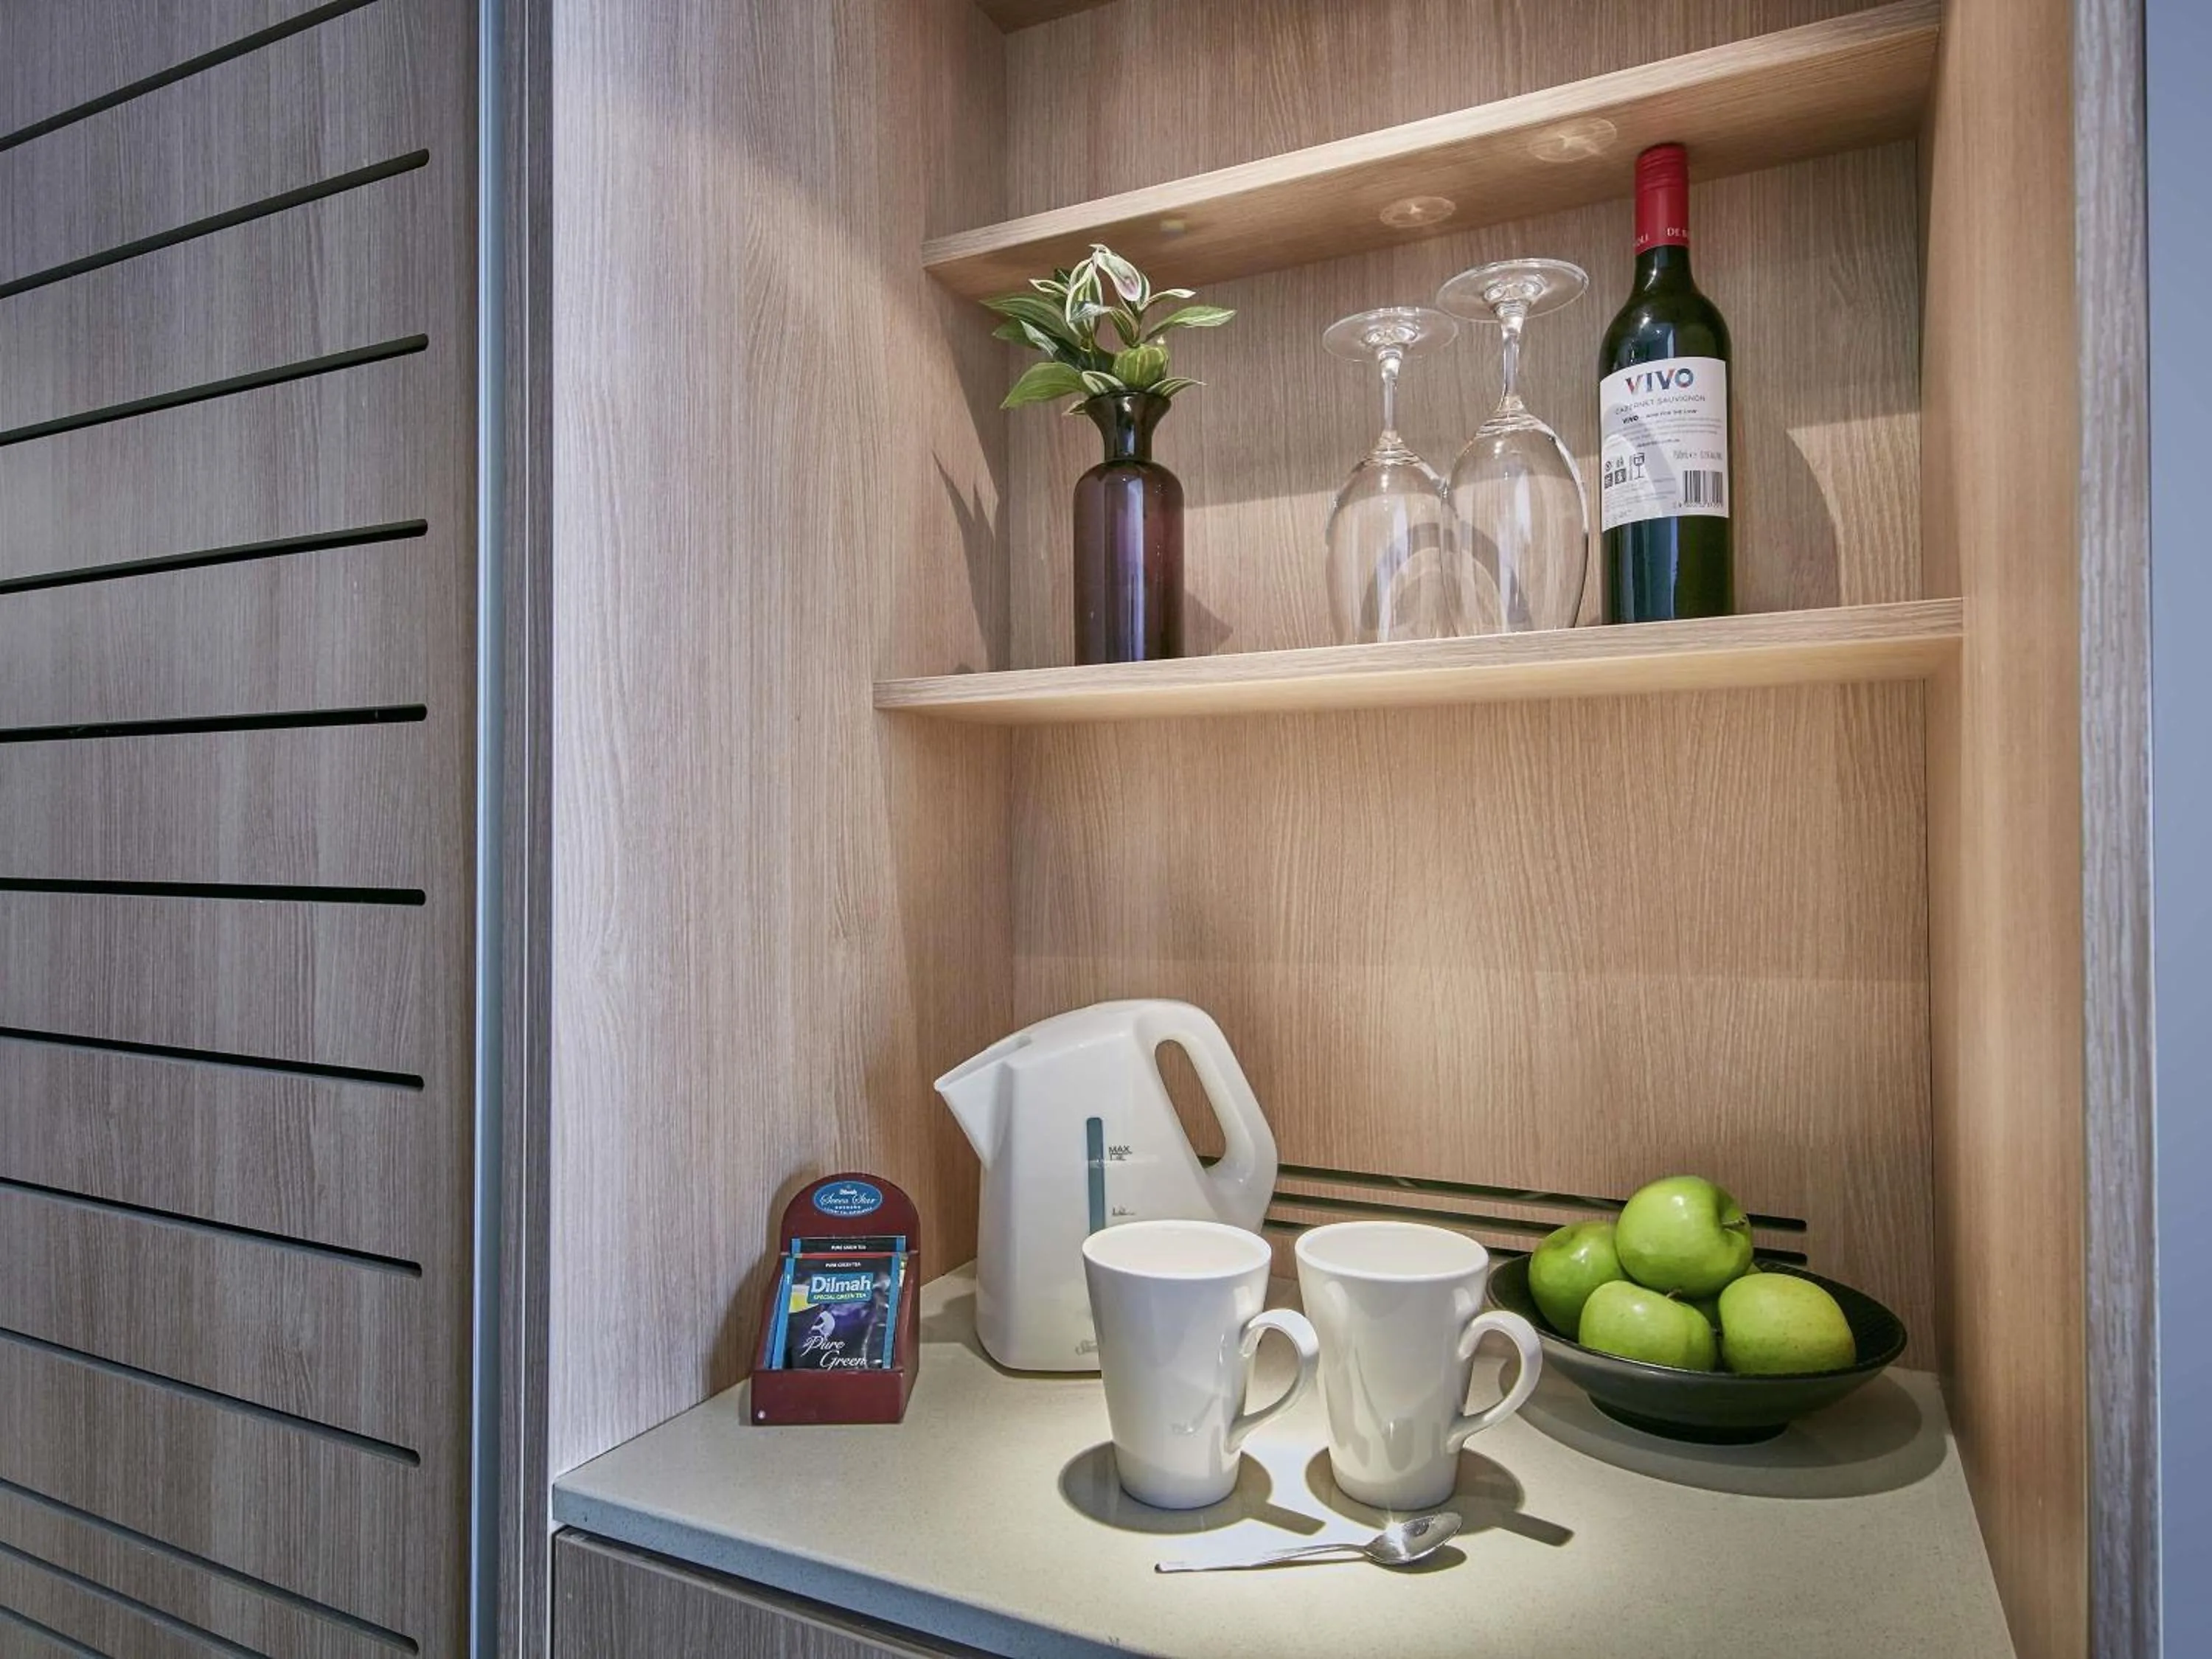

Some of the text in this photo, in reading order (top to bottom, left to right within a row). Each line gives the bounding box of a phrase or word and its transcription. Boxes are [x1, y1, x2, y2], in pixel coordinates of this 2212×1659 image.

[1625, 368, 1694, 394] VIVO
[812, 1275, 872, 1293] Dilmah
[800, 1335, 846, 1357] Pure
[819, 1350, 866, 1371] Green
